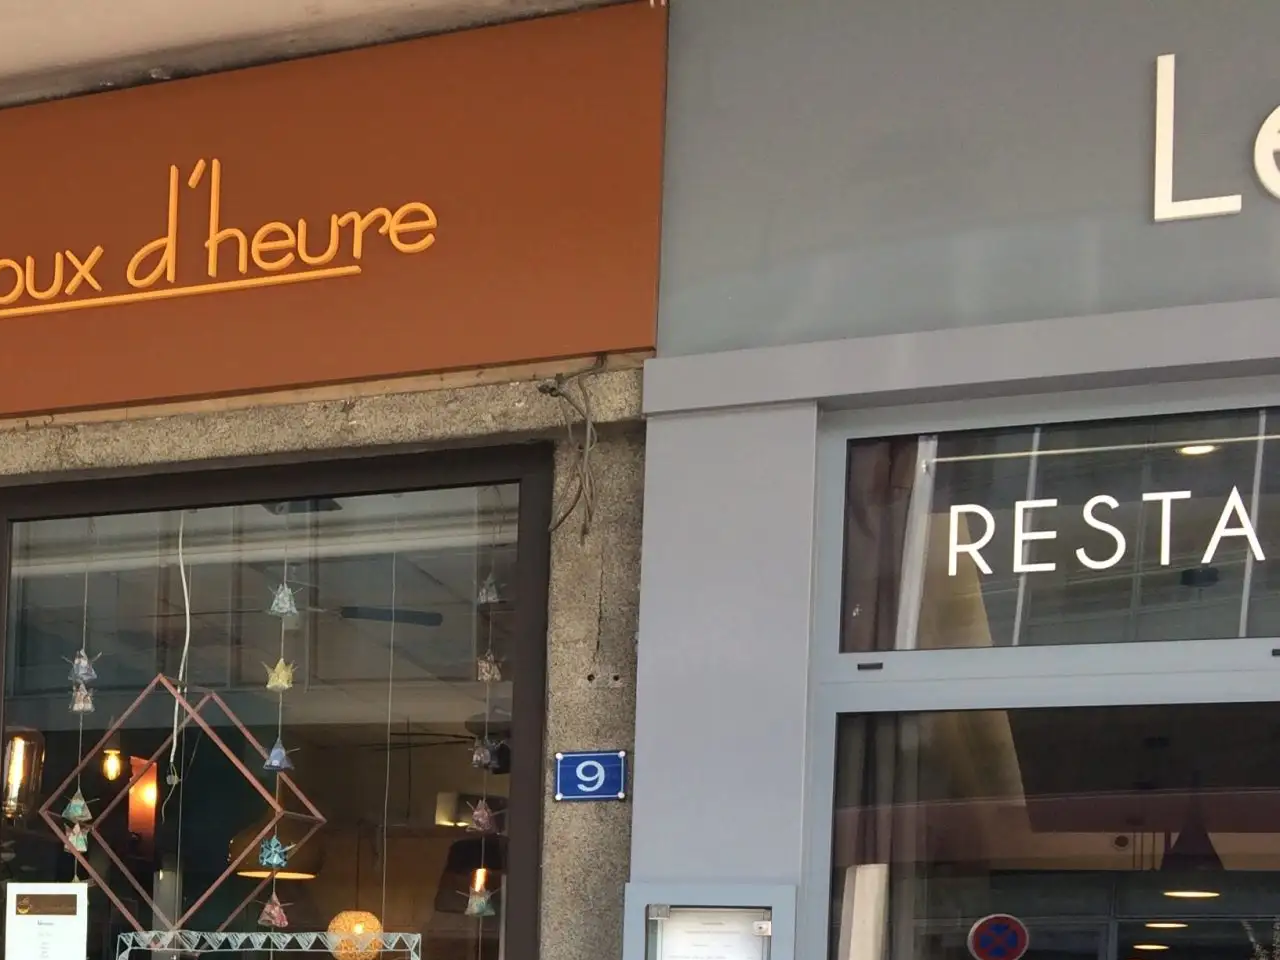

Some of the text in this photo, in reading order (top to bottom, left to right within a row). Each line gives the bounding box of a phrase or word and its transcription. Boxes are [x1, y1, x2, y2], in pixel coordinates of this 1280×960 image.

[127, 158, 437, 289] d'heure
[948, 486, 1267, 577] RESTA
[575, 760, 605, 792] 9
